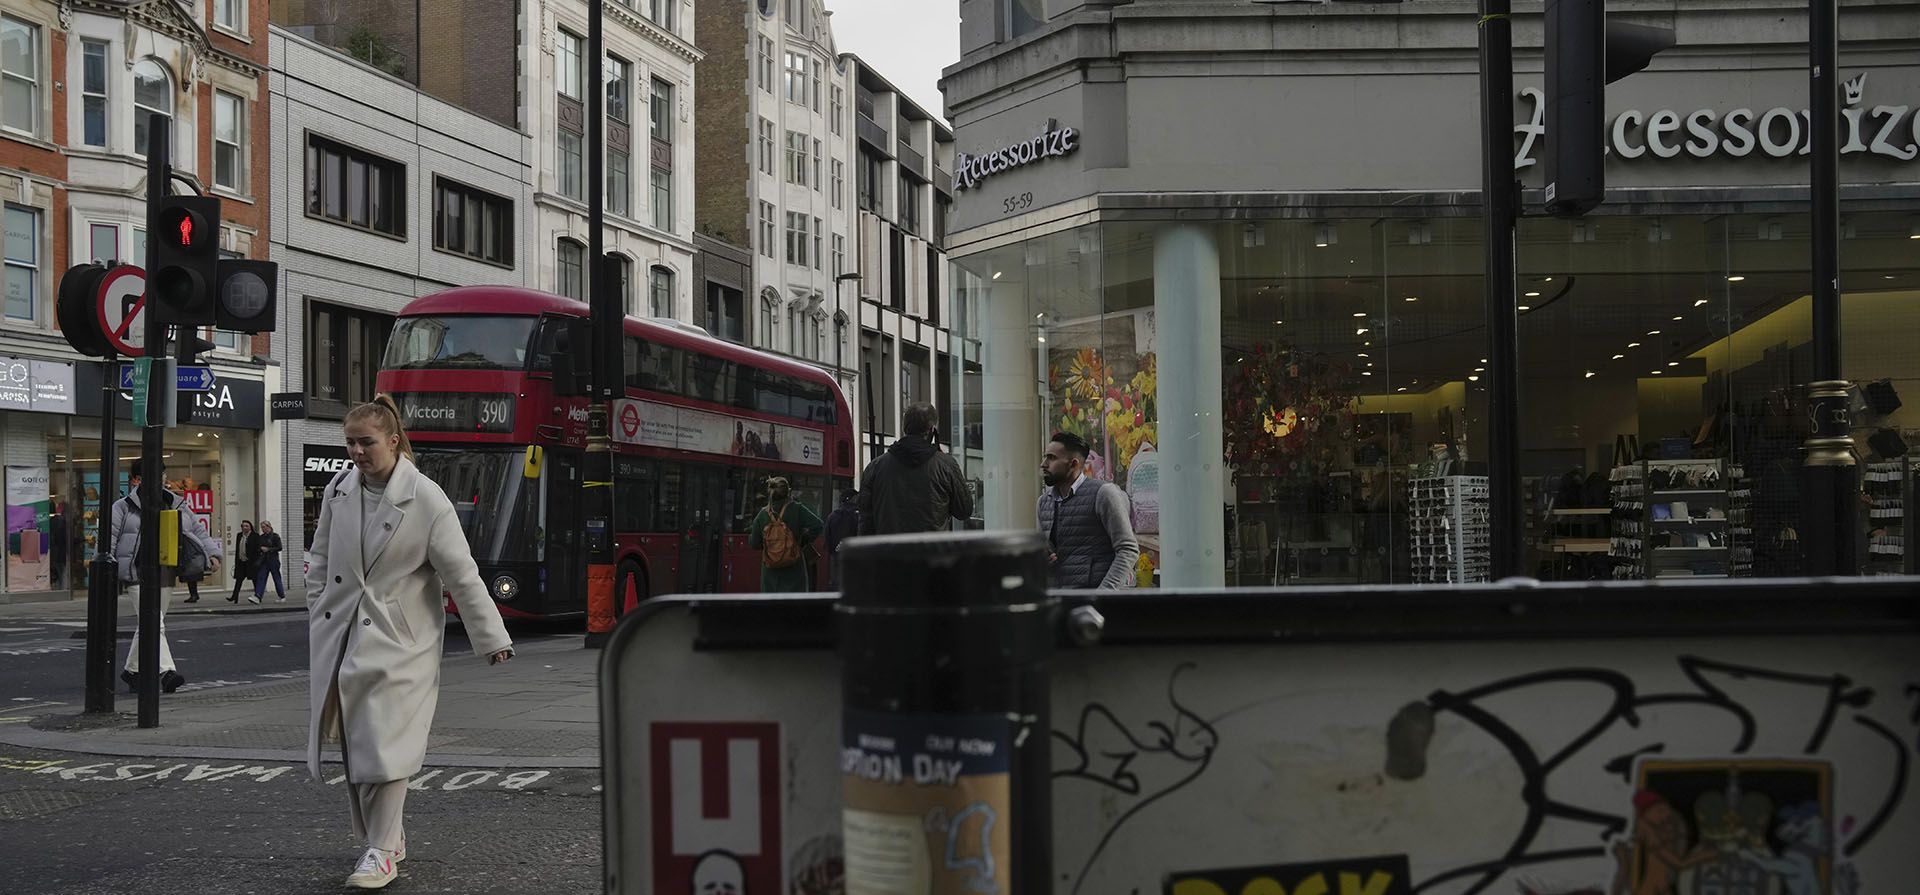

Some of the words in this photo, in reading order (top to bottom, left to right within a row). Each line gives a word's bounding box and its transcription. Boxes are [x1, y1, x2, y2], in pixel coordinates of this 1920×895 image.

[953, 121, 1075, 190] Accessorize
[1003, 191, 1033, 214] 55-59
[177, 375, 199, 383] uare
[272, 400, 304, 409] CARPISA
[192, 410, 221, 419] estyle
[404, 404, 456, 420] Victoria
[481, 401, 507, 424] 390
[304, 457, 355, 472] SKEC
[619, 463, 631, 475] 390
[186, 492, 212, 509] ALL
